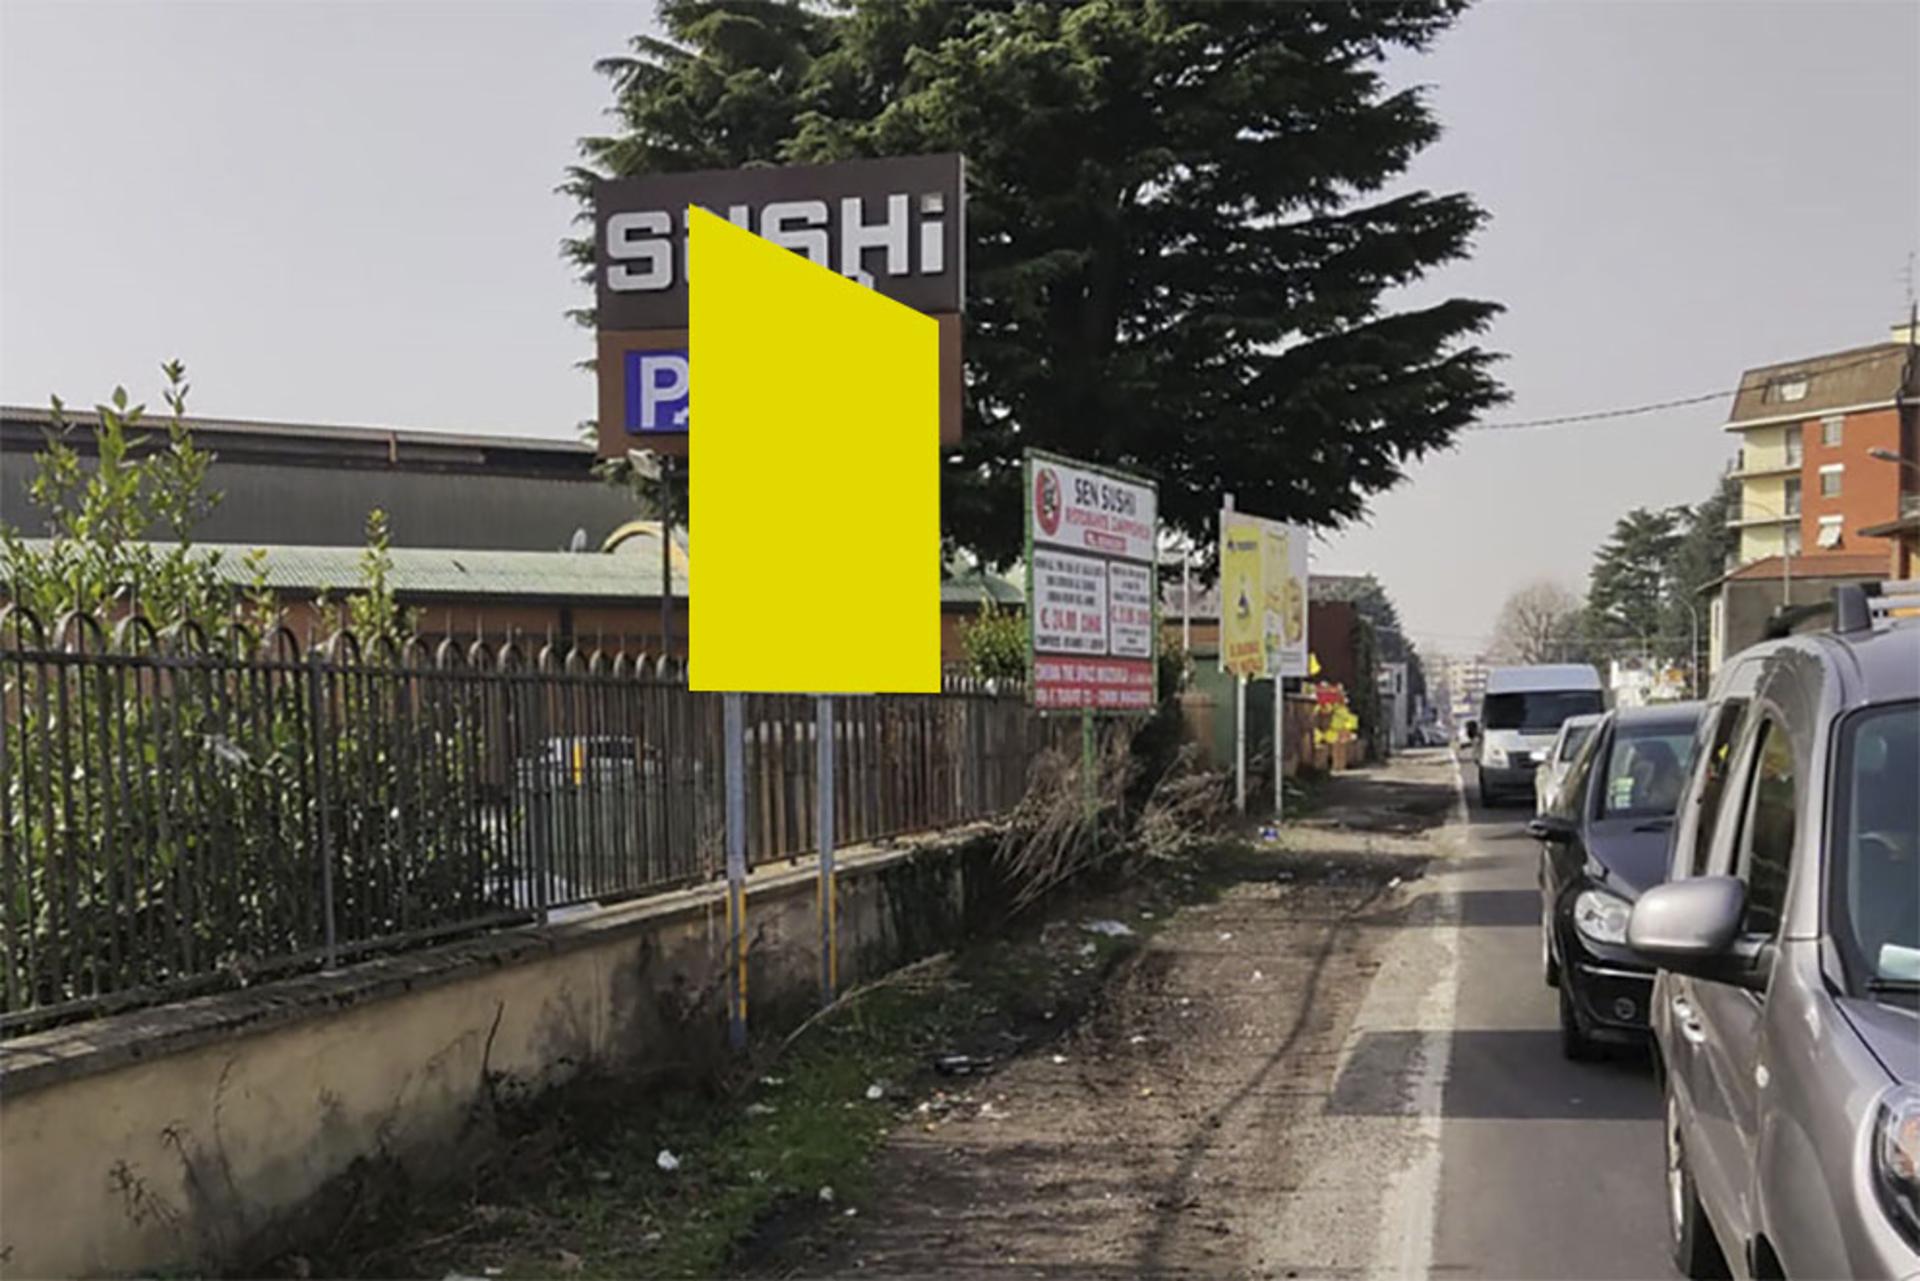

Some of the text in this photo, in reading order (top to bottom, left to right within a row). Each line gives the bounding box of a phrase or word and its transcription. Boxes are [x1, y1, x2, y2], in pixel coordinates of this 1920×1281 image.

[606, 193, 944, 291] SSHi
[640, 355, 690, 429] P
[1075, 477, 1136, 516] SEN SUSHI
